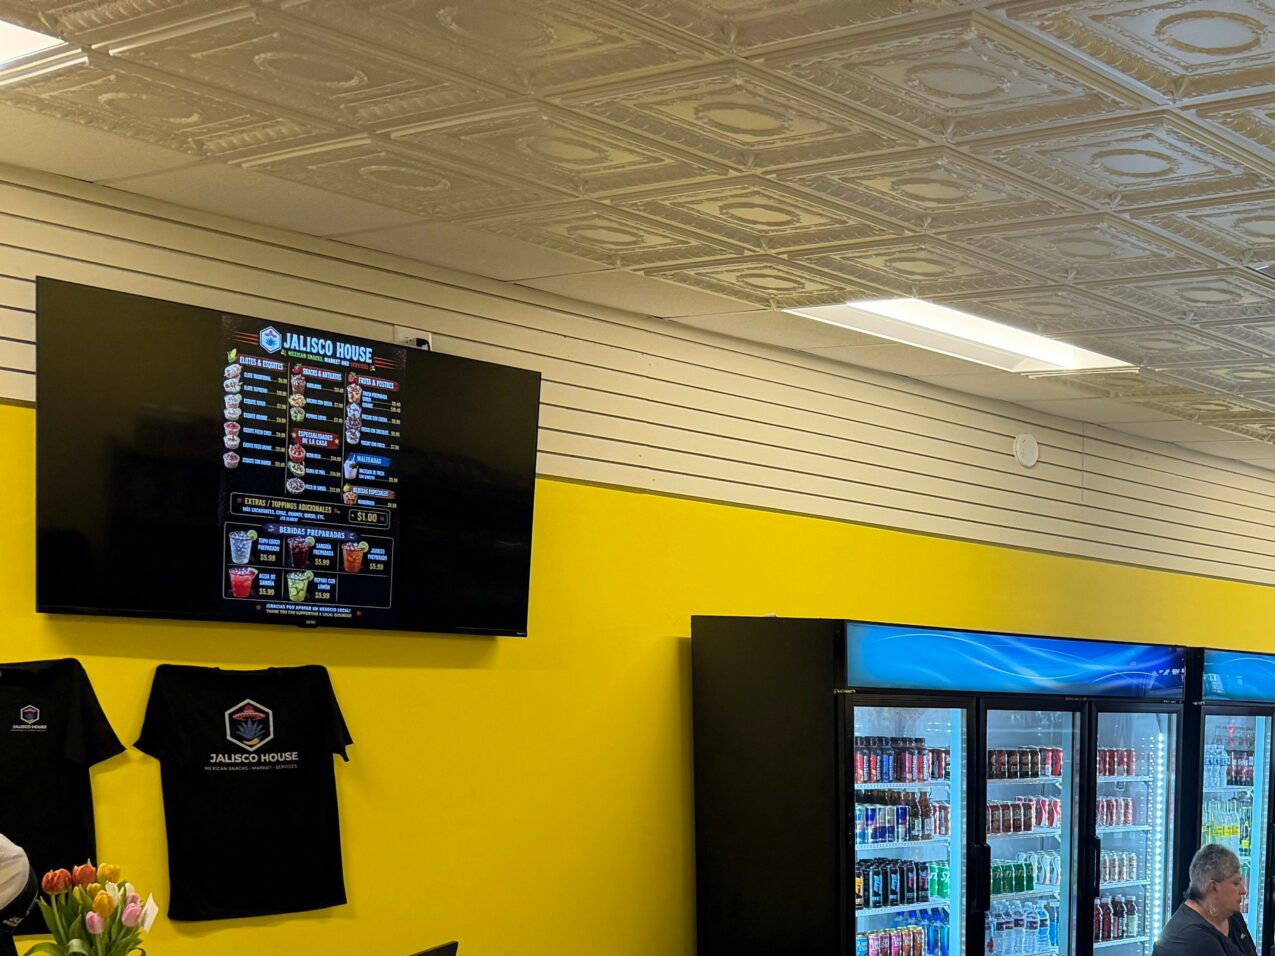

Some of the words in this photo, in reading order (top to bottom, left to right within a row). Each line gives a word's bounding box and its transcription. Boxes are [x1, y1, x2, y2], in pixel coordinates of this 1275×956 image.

[284, 332, 333, 356] JALISCO
[336, 342, 373, 363] HOUSE
[240, 356, 257, 366] ELOTES
[302, 368, 318, 376] SNACKS
[298, 430, 333, 441] ESPECIALIDADES
[244, 498, 267, 507] EXTRAS
[271, 500, 298, 510] TOPPINGS
[299, 504, 333, 514] ADICIONALES
[357, 512, 378, 522] $1.00
[279, 526, 306, 536] BEBIDAS
[307, 528, 345, 539] PREPARADAS
[210, 753, 259, 763] JALISCO
[260, 751, 299, 763] HOUSE
